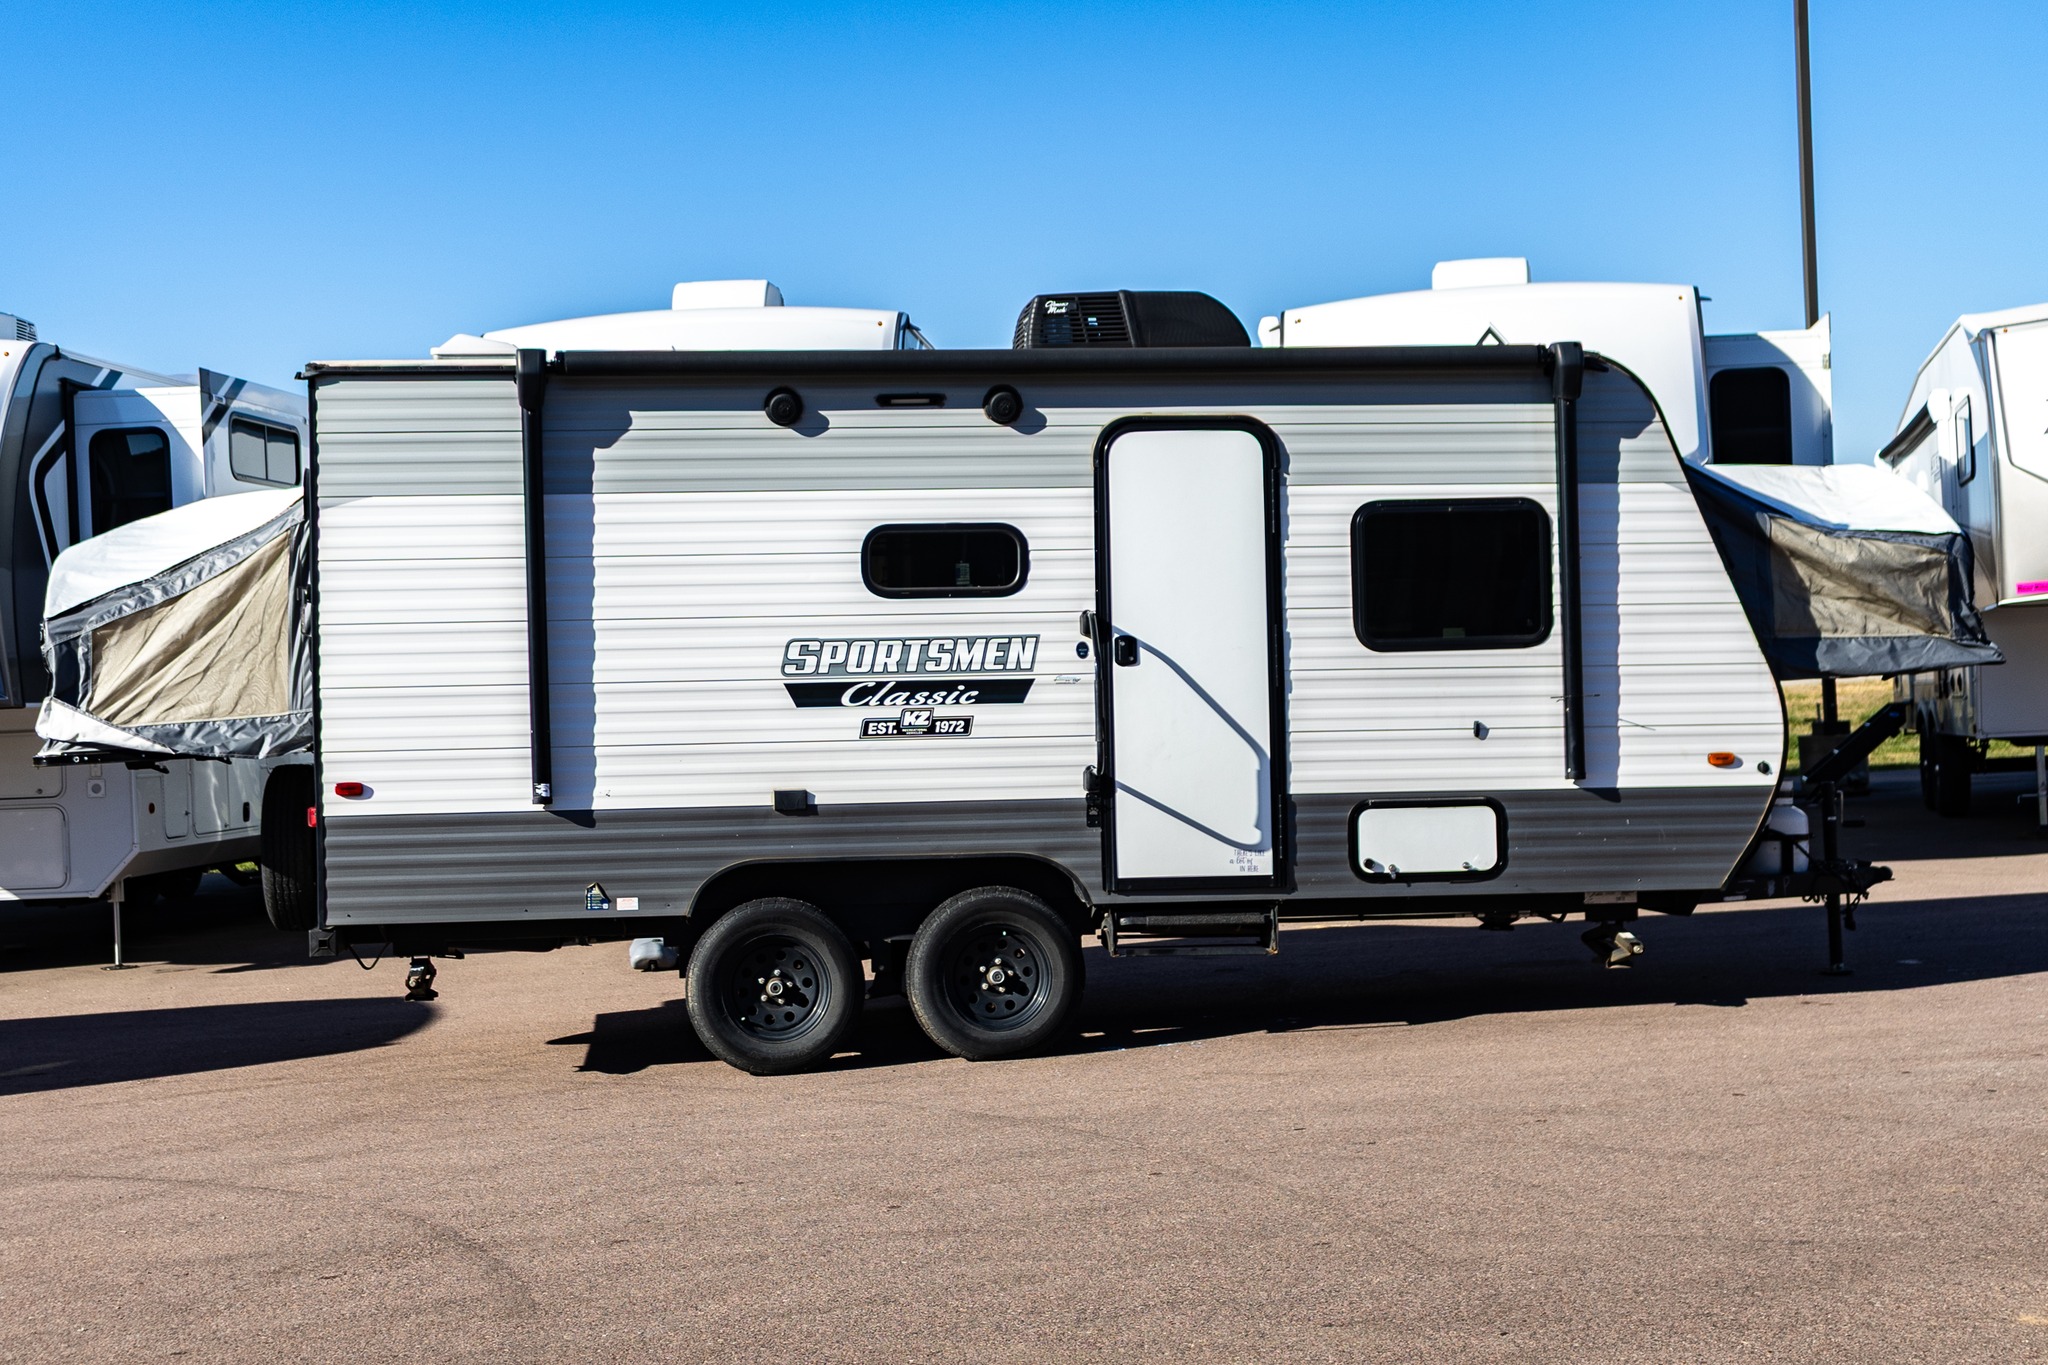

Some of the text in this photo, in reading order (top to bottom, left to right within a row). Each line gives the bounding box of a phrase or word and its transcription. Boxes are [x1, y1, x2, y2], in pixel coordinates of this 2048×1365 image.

[783, 636, 1038, 675] SPORTSMEN
[841, 681, 980, 707] Classic
[867, 720, 965, 735] EST. 1972
[903, 710, 931, 726] KZ
